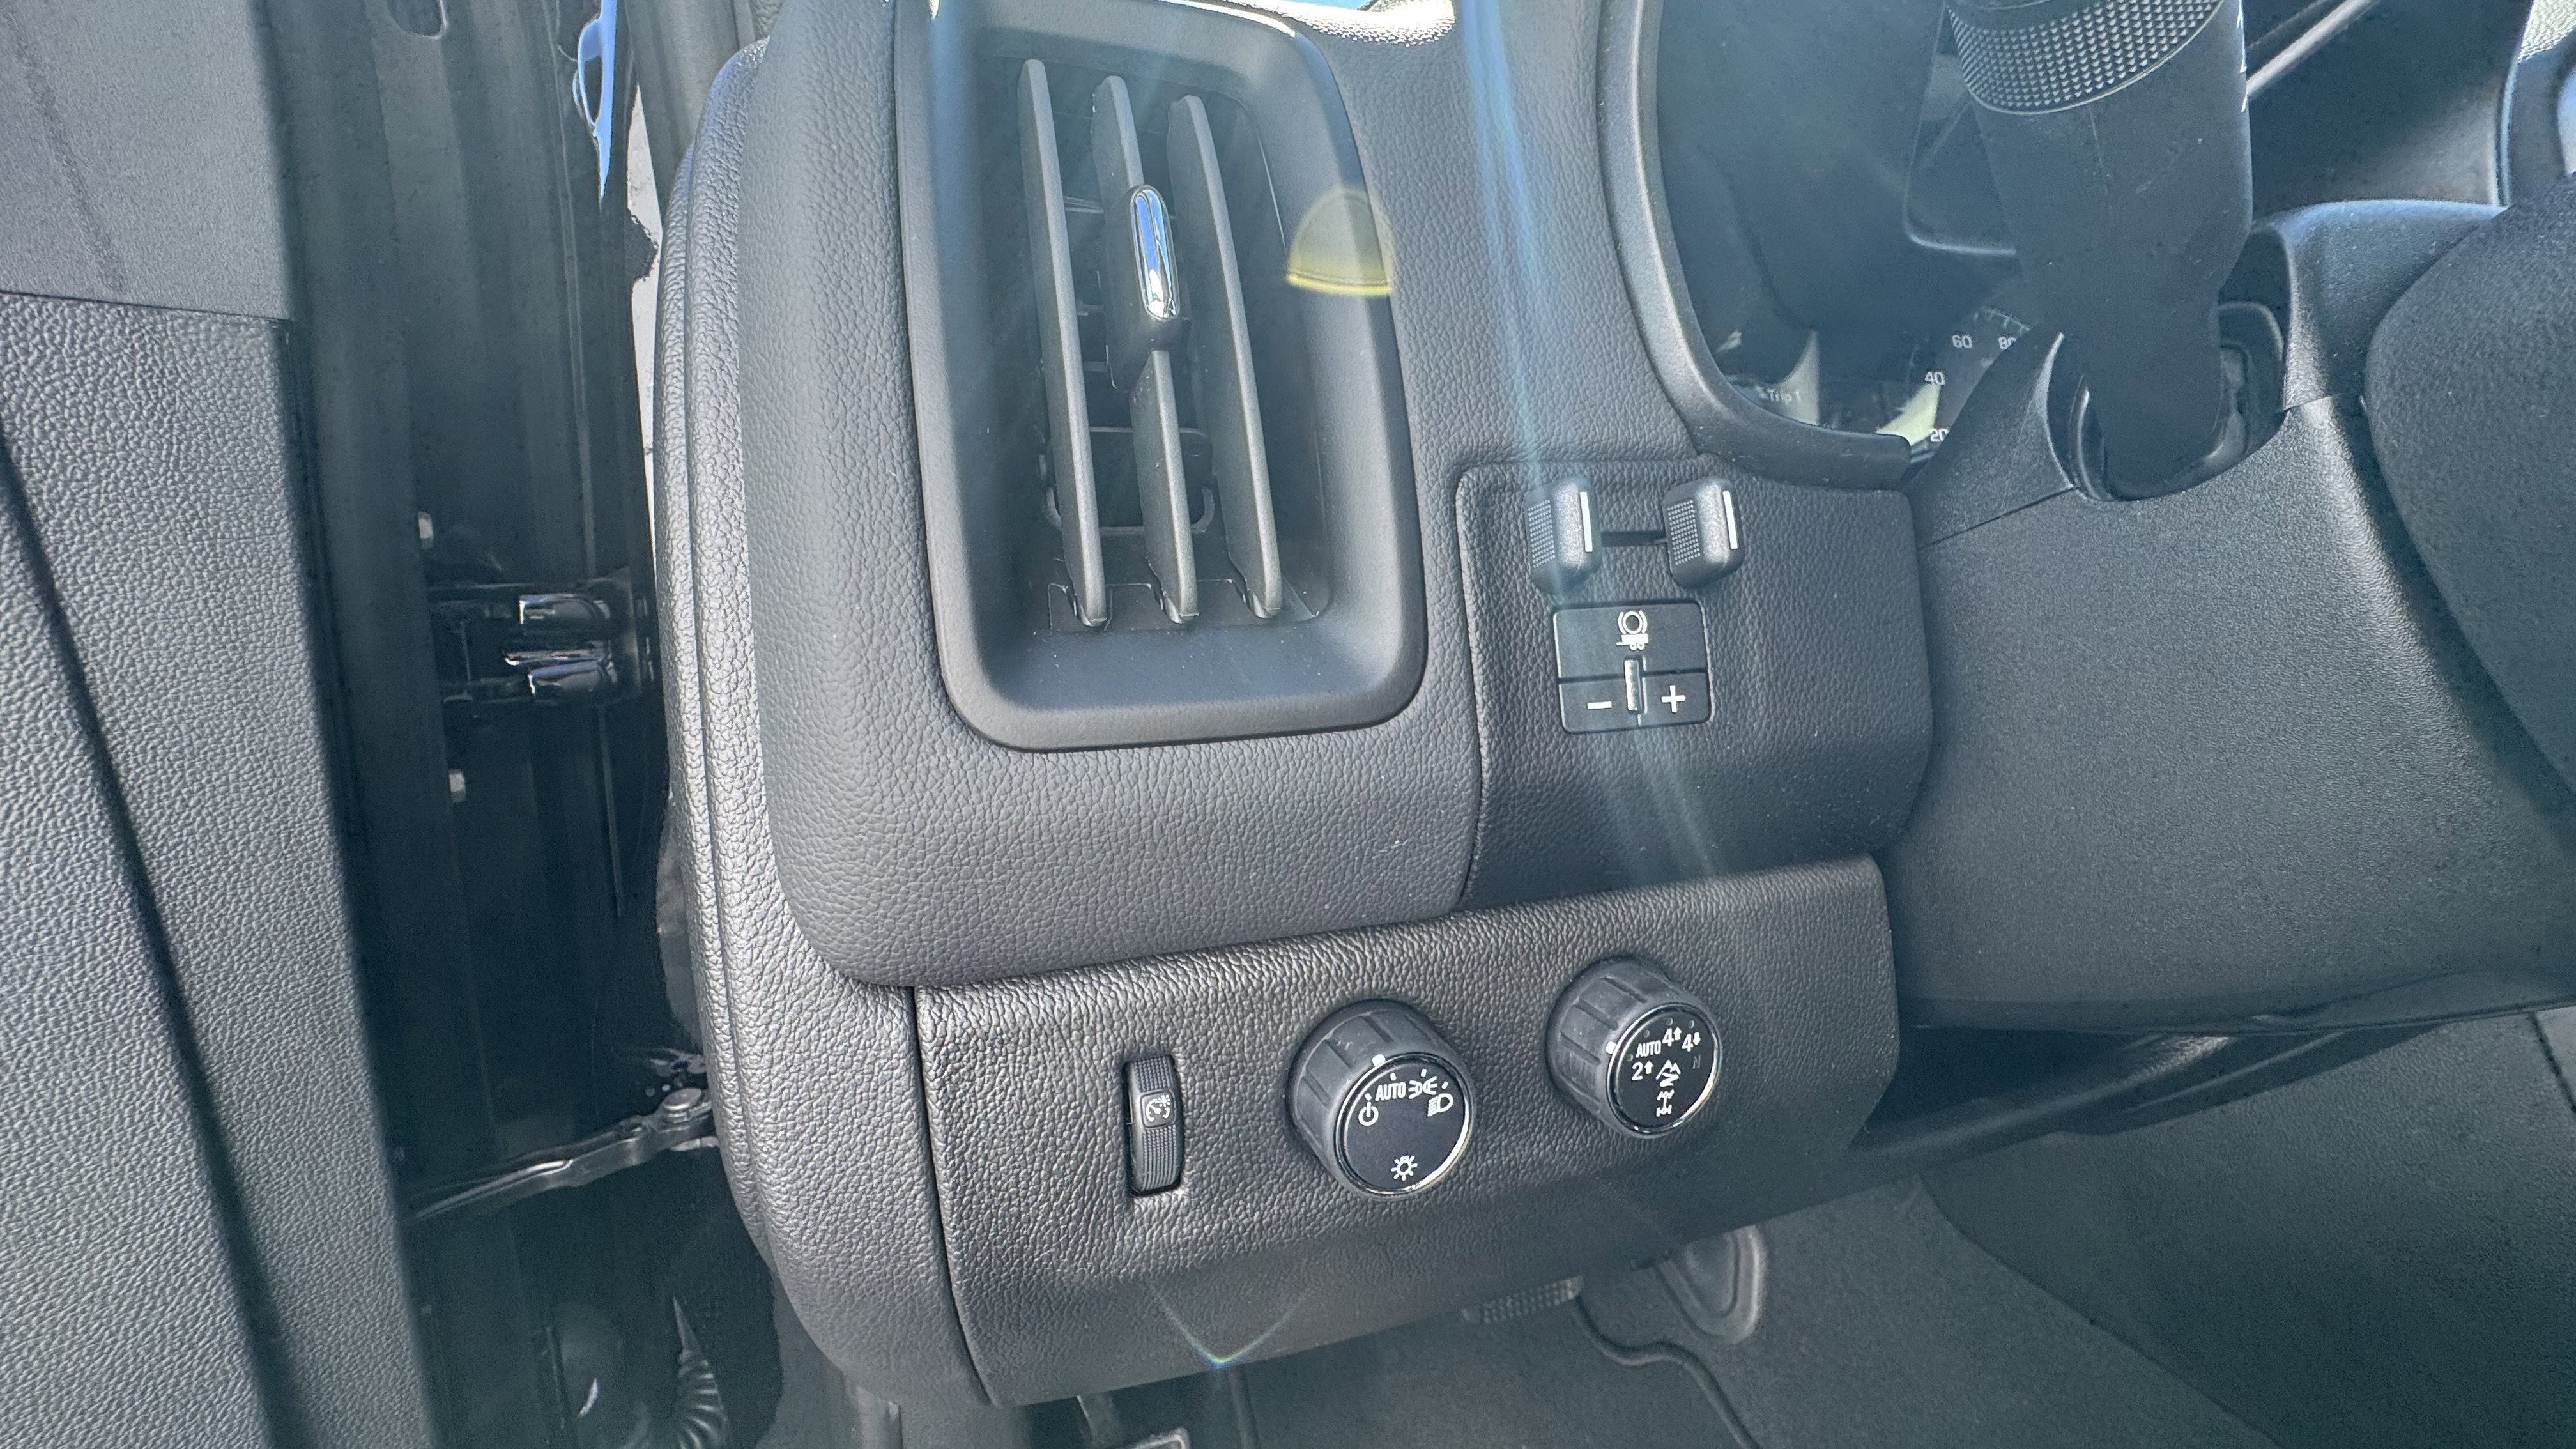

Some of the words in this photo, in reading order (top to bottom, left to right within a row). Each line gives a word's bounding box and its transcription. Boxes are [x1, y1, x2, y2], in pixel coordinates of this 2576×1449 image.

[1952, 335, 1972, 349] 60
[1924, 371, 1945, 386] 40
[1929, 428, 1949, 442] 20
[1636, 1039, 1662, 1058] AUTO
[1375, 1082, 1406, 1101] AUTO
